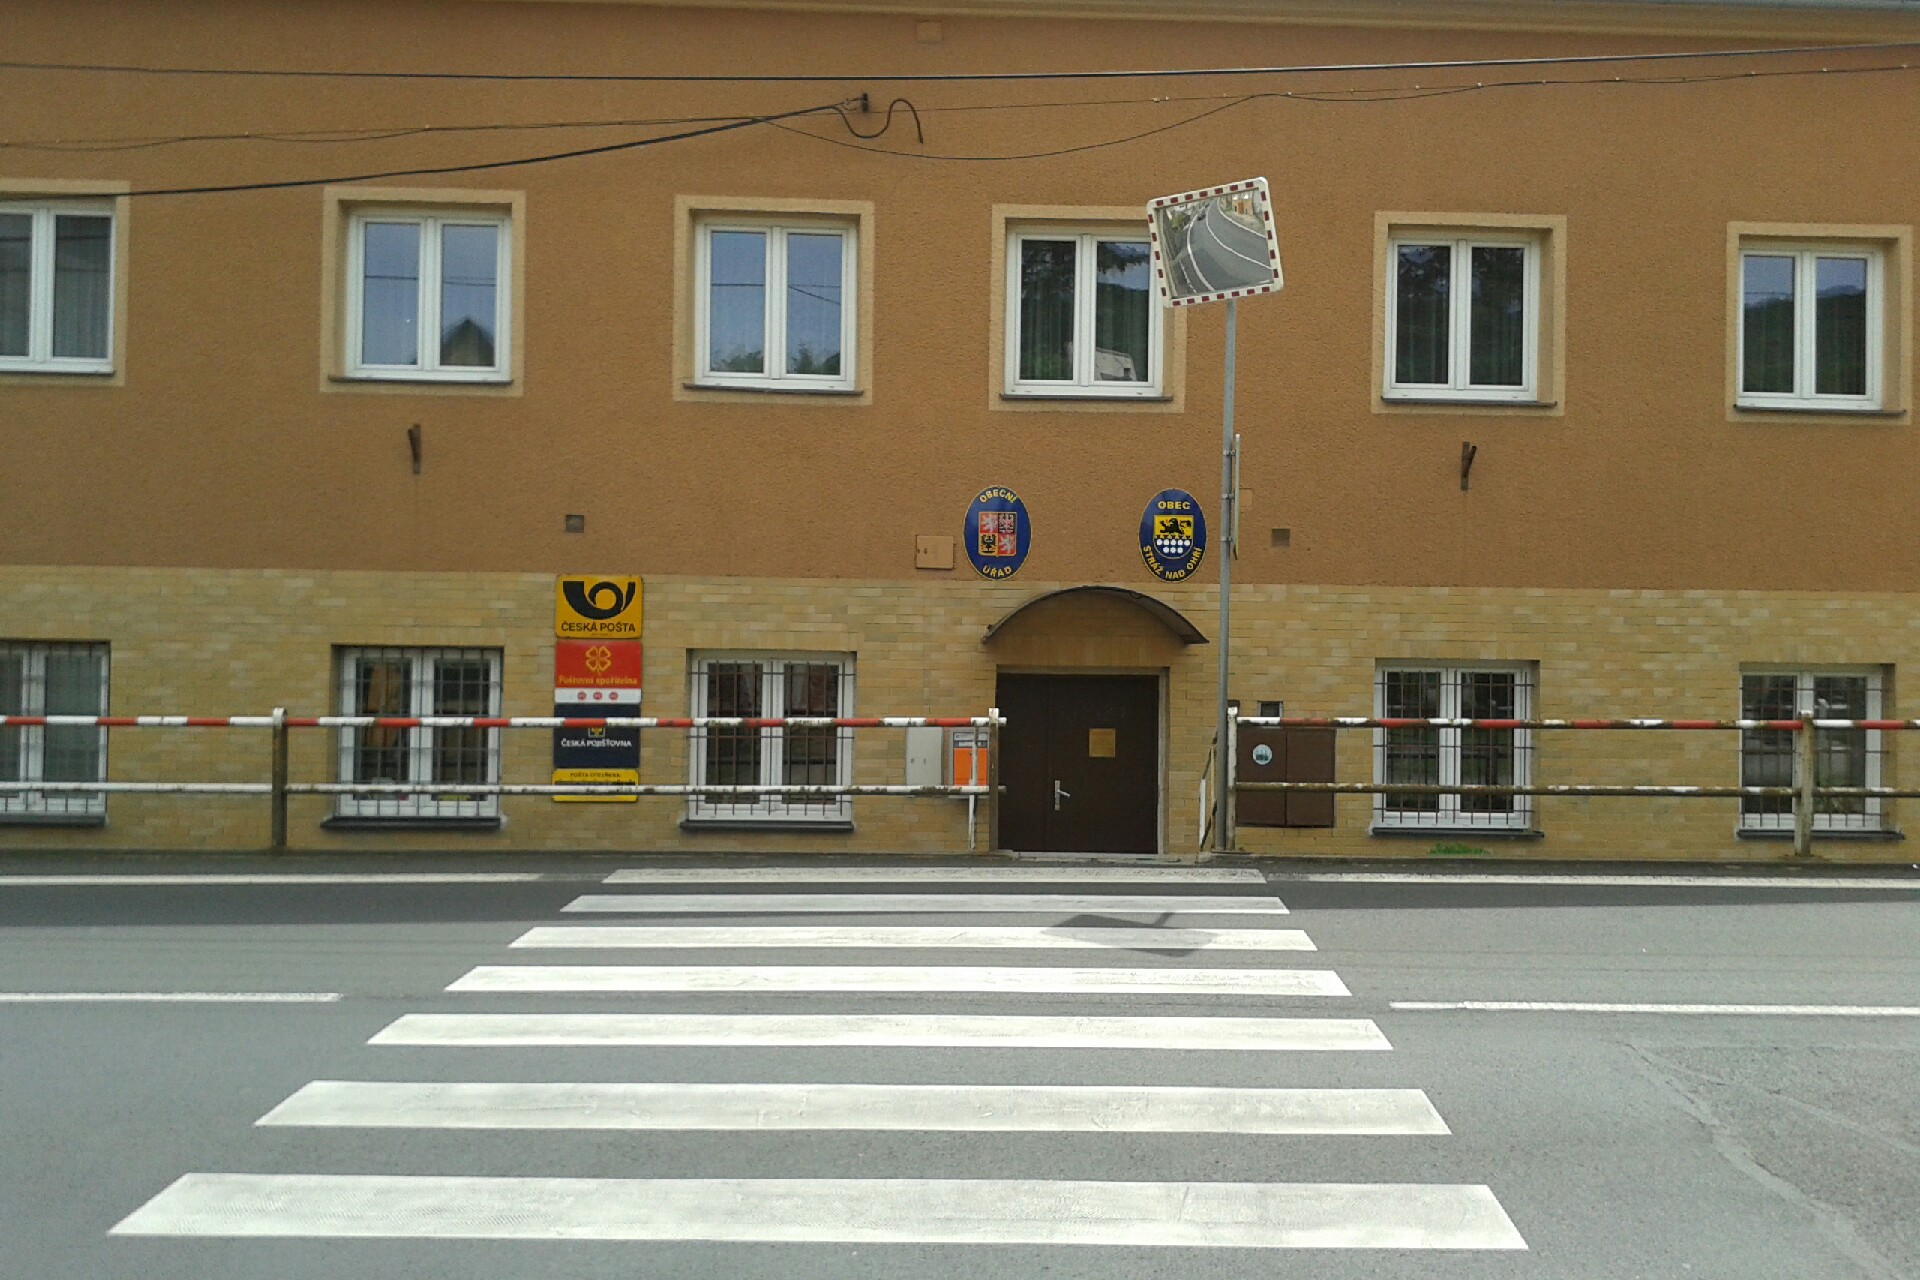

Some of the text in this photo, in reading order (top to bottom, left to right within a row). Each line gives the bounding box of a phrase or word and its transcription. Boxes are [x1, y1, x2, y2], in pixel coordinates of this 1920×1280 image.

[1157, 501, 1191, 510] OBEC
[1165, 569, 1185, 579] NAD
[561, 620, 636, 632] ČESKÁ POŠTA
[561, 738, 586, 747] ČESKÁ
